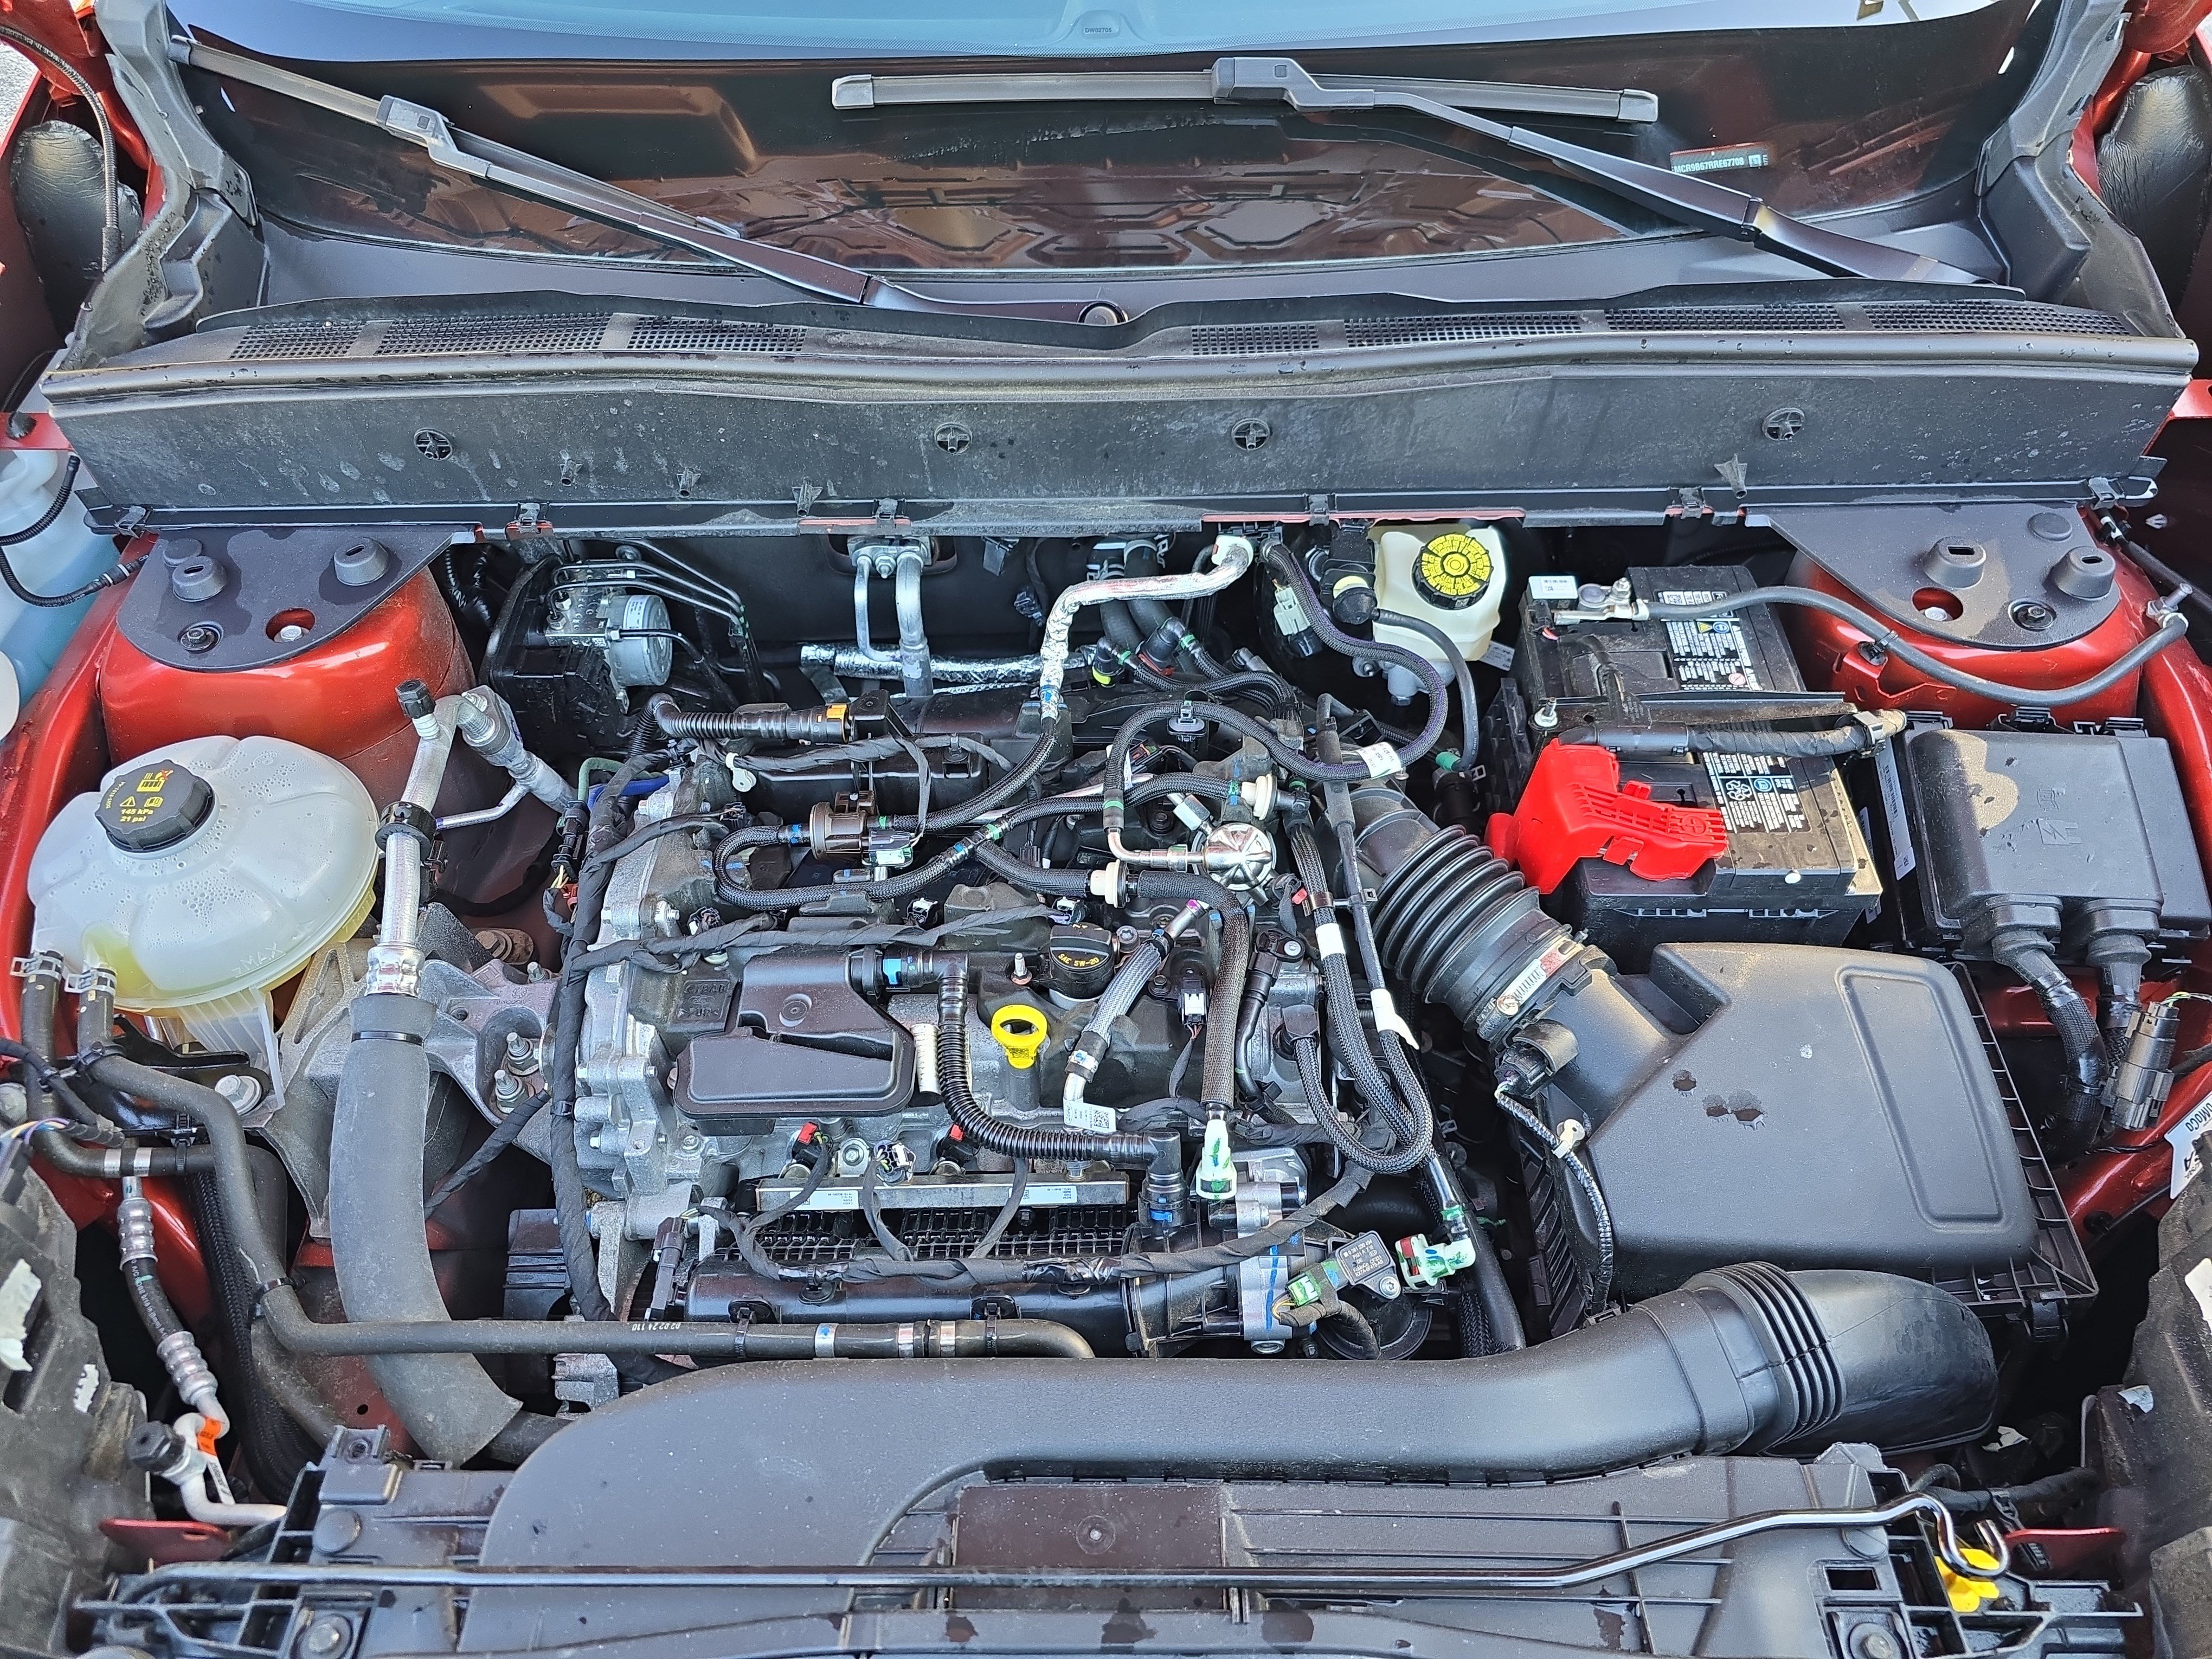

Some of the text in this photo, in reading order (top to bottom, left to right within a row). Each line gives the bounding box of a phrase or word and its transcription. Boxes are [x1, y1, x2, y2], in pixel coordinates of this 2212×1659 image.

[1439, 587, 1456, 595] SEALED
[1457, 582, 1481, 595] CONTAINER
[240, 942, 283, 970] MAX
[1058, 954, 1099, 967] SAE 5W-20
[2185, 1102, 2212, 1132] oMoCo
[1353, 1263, 1369, 1272] FoMoCo
